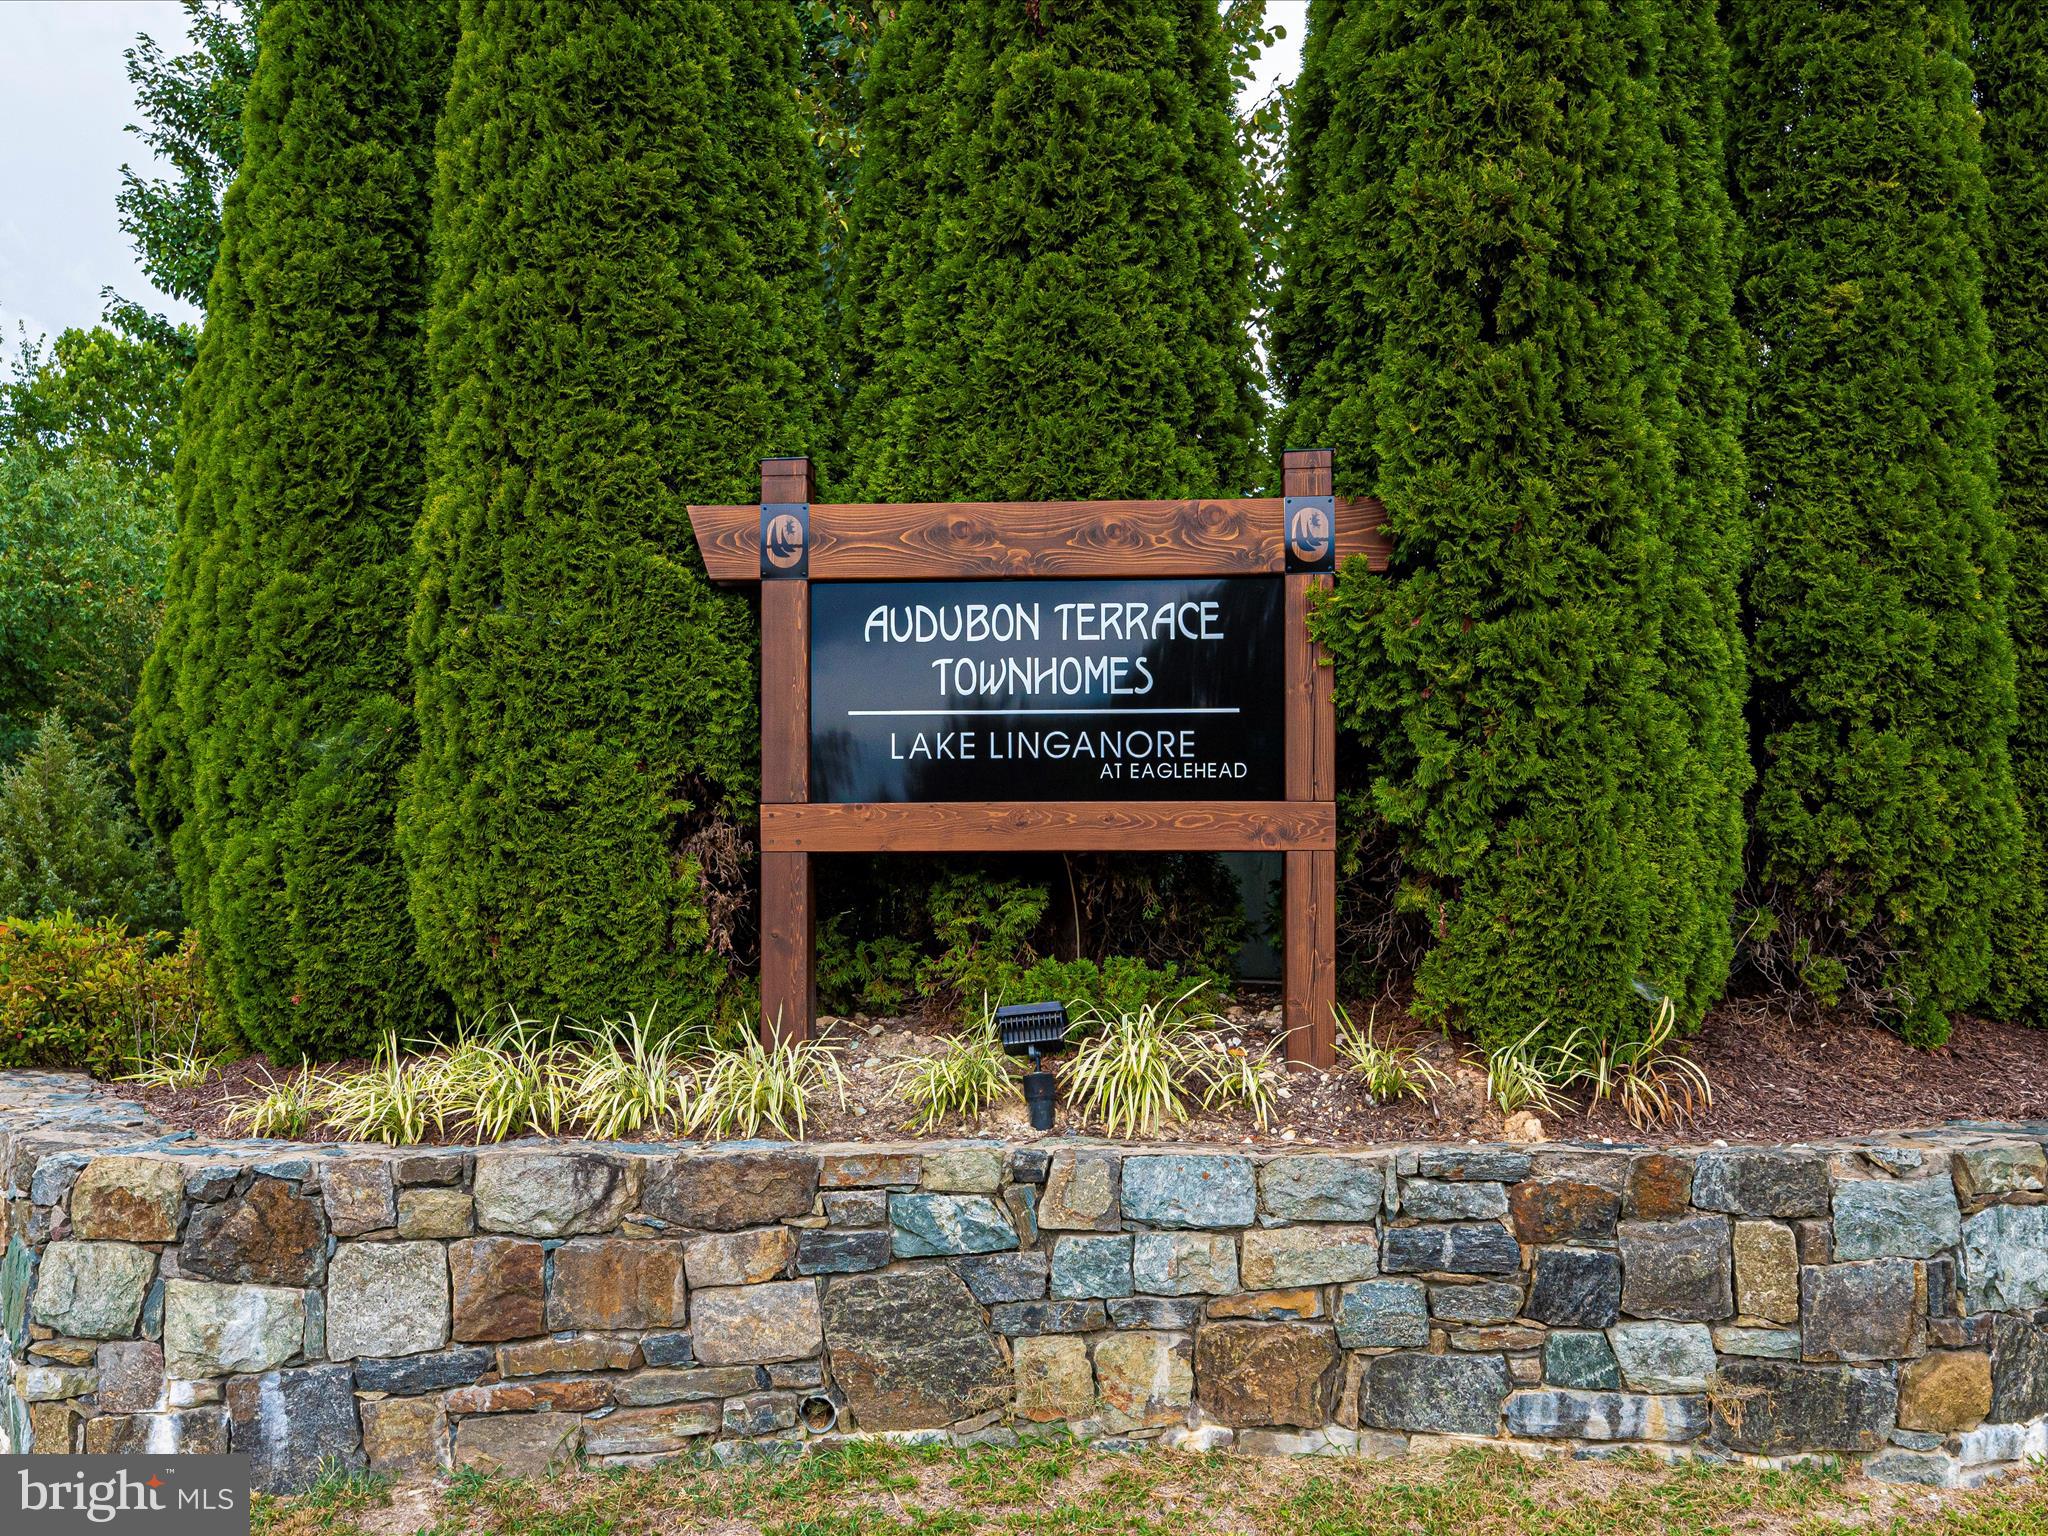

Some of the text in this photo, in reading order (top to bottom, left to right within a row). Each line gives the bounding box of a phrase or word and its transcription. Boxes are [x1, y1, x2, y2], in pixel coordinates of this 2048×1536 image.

[864, 601, 1225, 643] AUDUBON TERRACE
[931, 655, 1154, 696] TOWNHOMES
[890, 730, 1196, 760] LAKE LINGANORE
[1100, 762, 1248, 779] AT EAGLEHEAD
